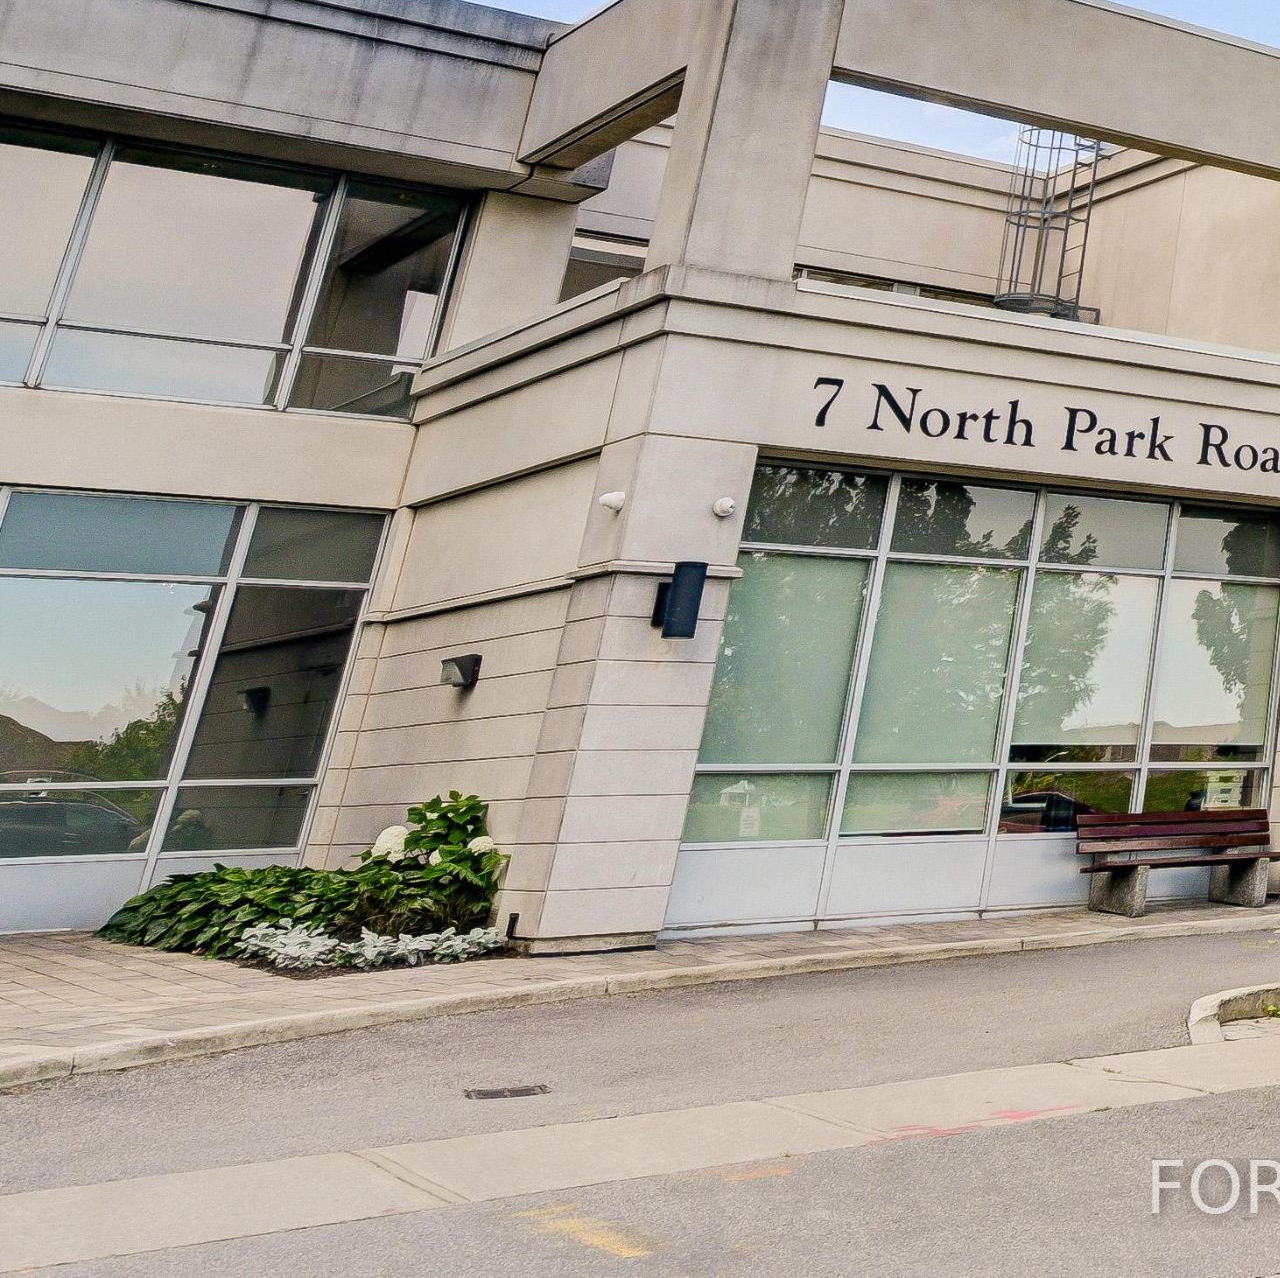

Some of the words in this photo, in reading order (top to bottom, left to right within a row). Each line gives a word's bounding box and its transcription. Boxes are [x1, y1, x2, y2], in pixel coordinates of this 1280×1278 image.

[813, 377, 845, 427] 7
[866, 383, 1036, 448] North
[1060, 406, 1174, 462] Park
